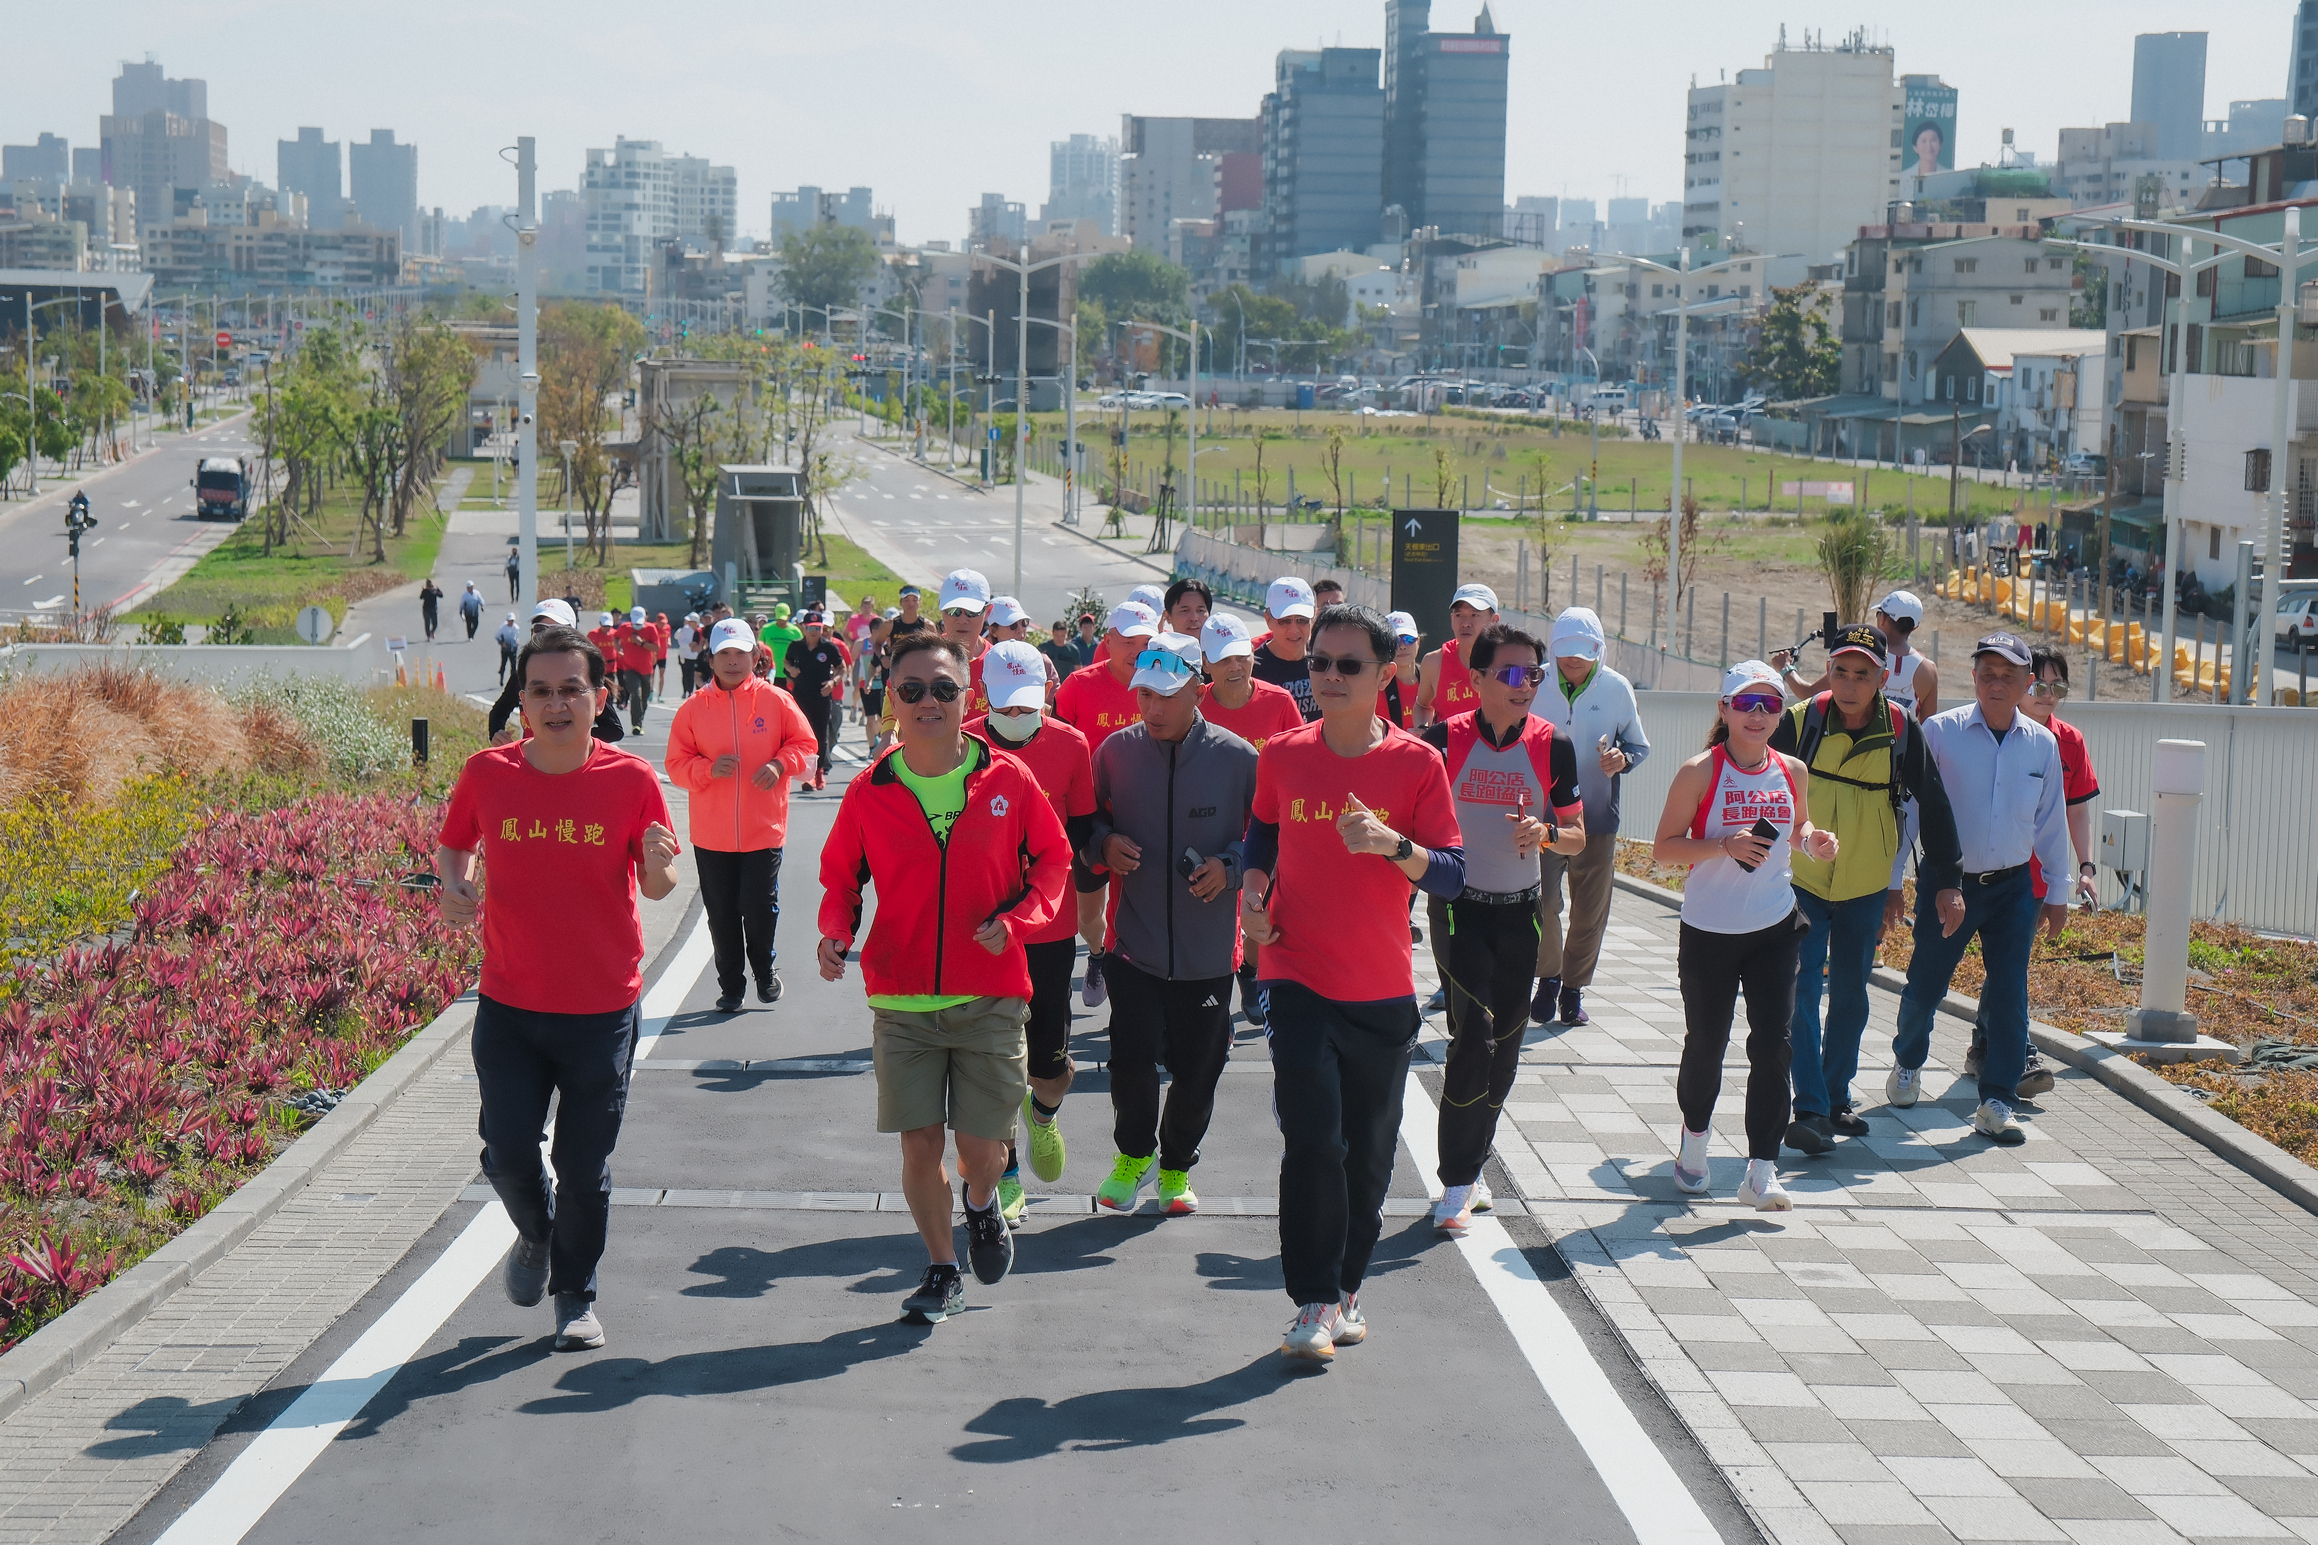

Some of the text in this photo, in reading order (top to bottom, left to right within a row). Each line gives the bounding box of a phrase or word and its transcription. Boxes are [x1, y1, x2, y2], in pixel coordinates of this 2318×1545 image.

[1905, 97, 1955, 118] 林岱樺
[1447, 686, 1482, 702] 鳳山
[1469, 768, 1525, 786] 阿公店
[1725, 790, 1788, 806] 阿公店
[1722, 805, 1791, 820] 長跑協會
[500, 817, 605, 846] 鳳山慢跑
